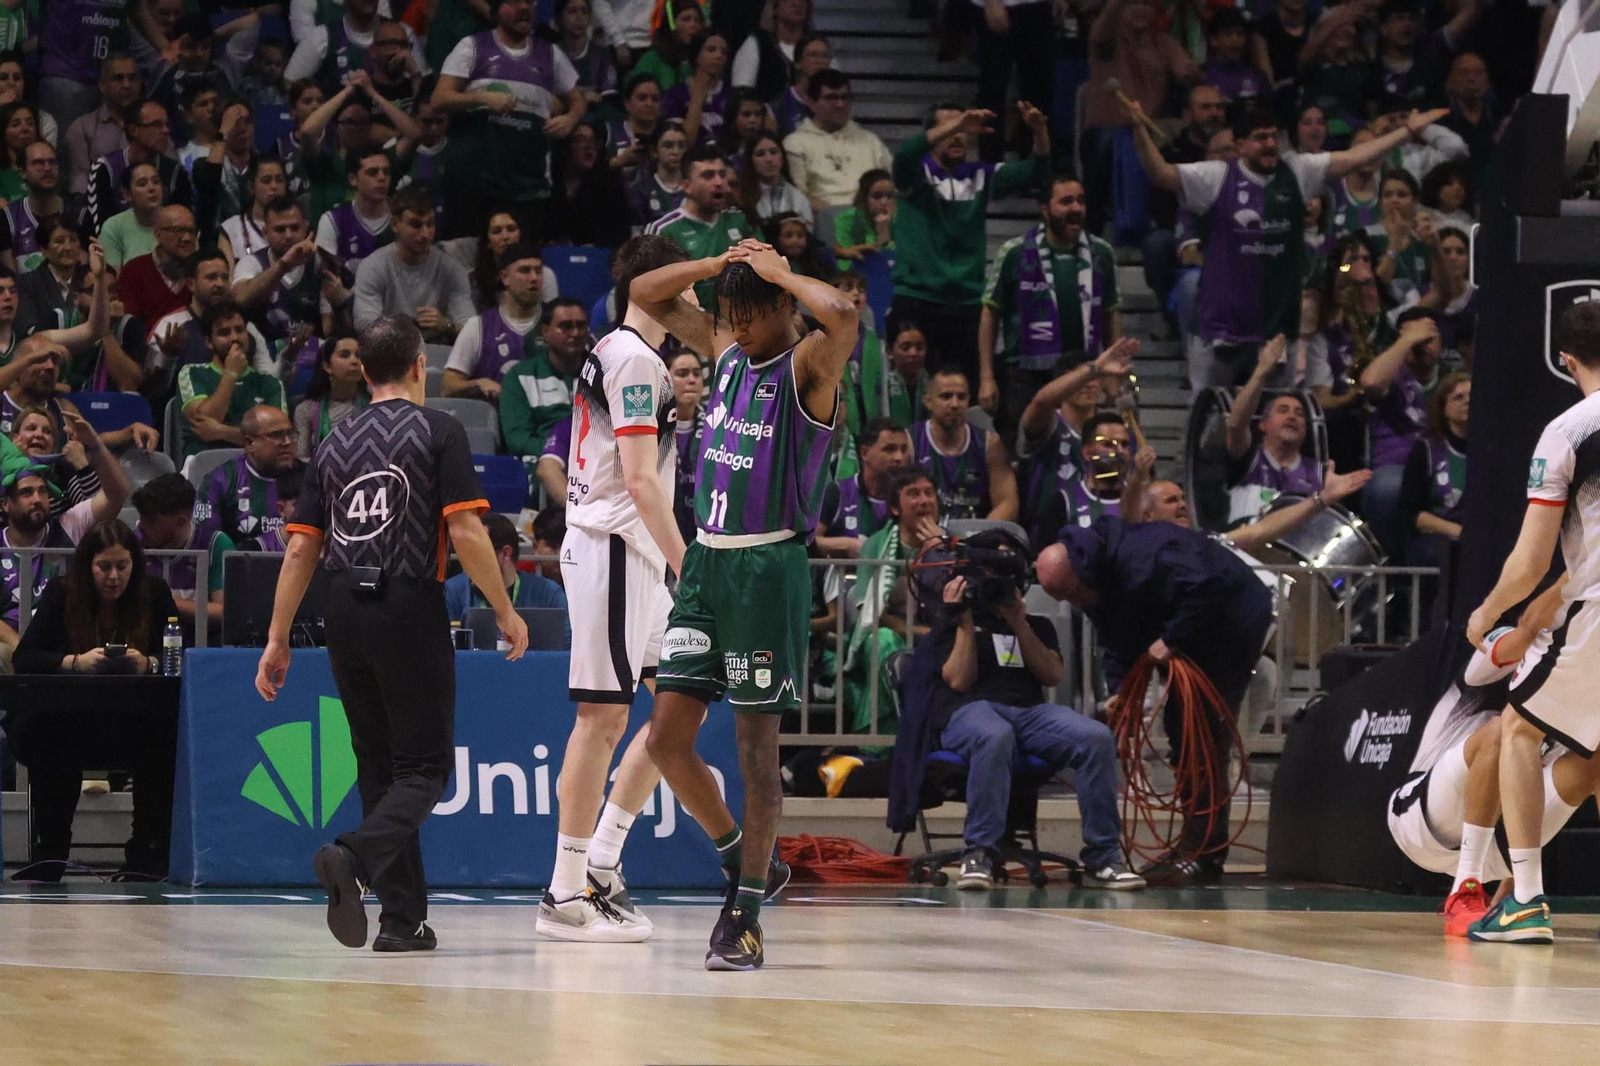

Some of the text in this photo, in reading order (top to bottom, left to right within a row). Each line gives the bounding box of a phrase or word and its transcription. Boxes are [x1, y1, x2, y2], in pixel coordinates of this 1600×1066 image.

[92, 35, 110, 60] 16
[723, 412, 774, 441] Unicaja
[703, 443, 754, 472] málaga
[347, 486, 389, 524] 44
[706, 488, 728, 529] 11
[725, 664, 749, 685] laga
[728, 653, 749, 670] má
[1366, 708, 1412, 737] Fundación
[1359, 736, 1393, 770] Unicaja
